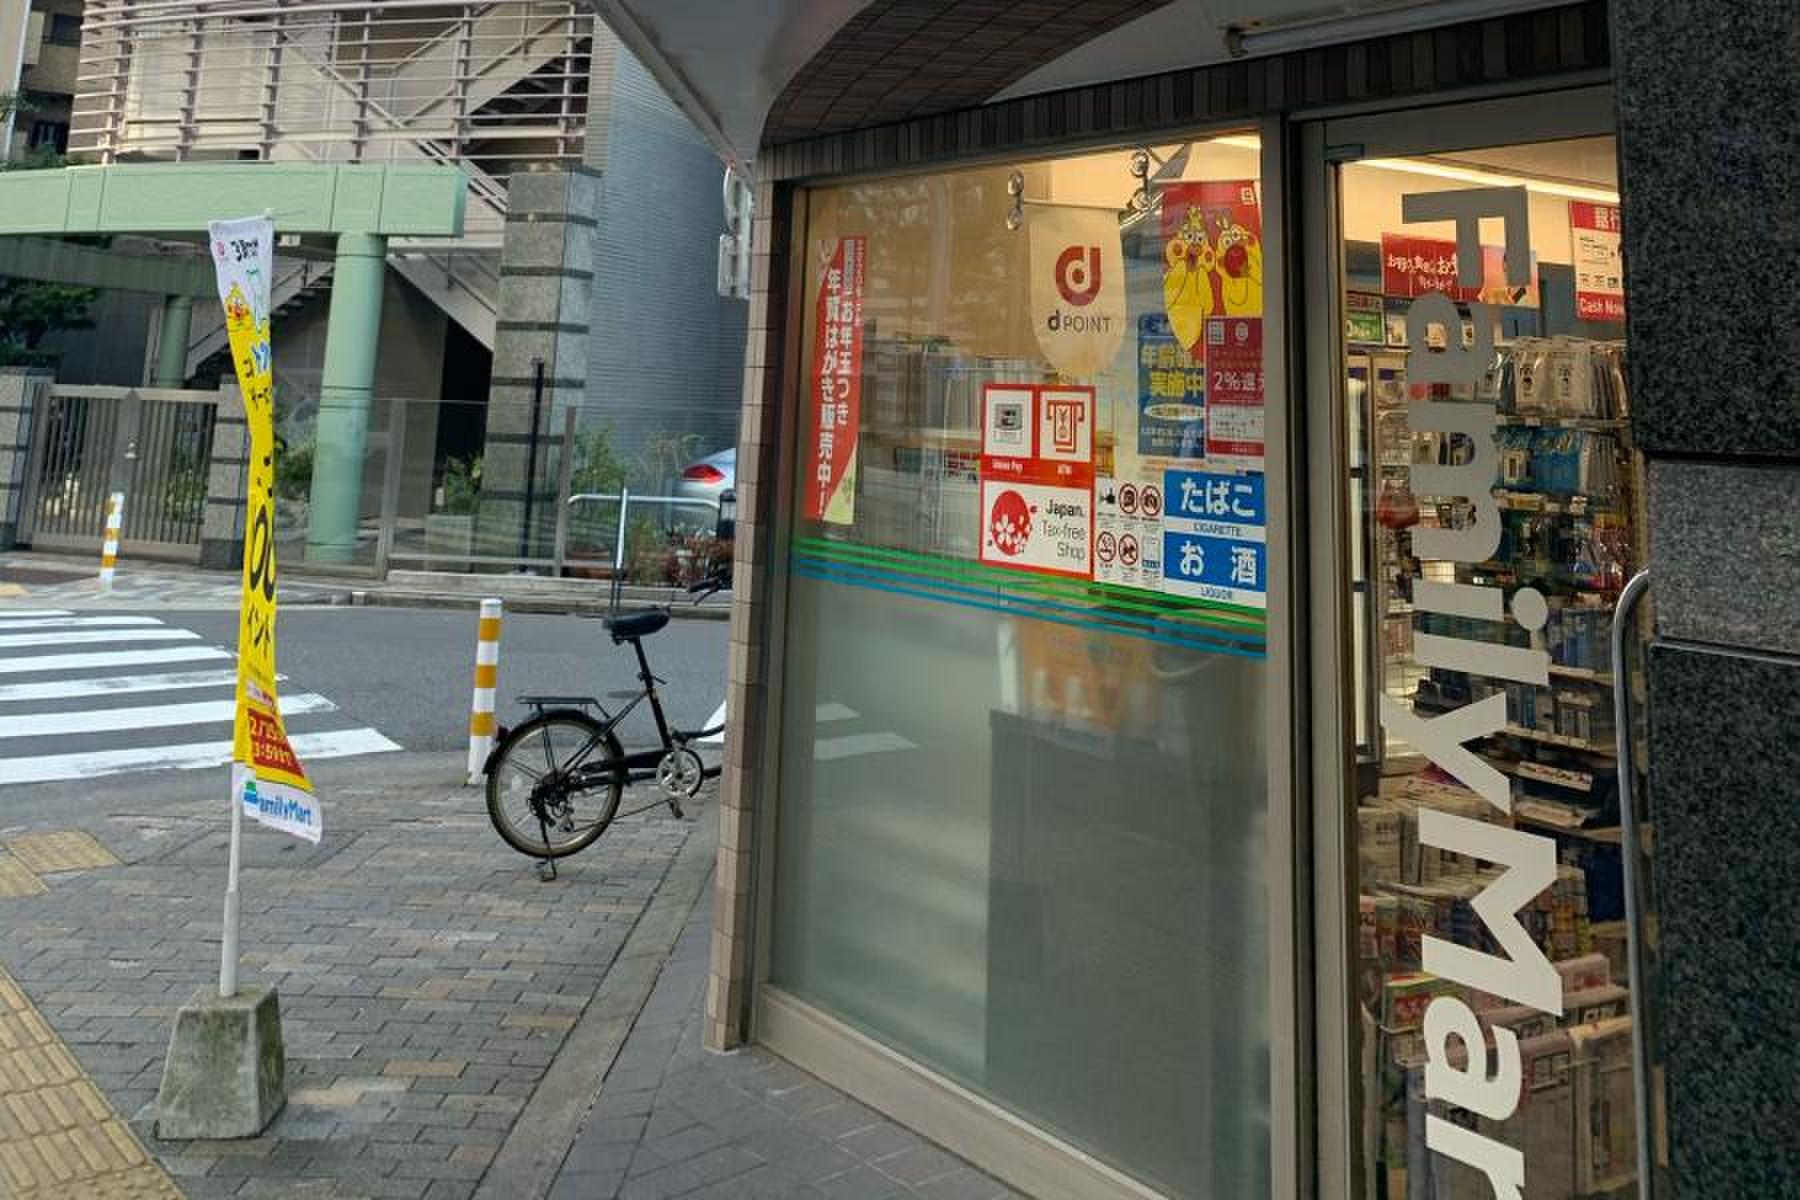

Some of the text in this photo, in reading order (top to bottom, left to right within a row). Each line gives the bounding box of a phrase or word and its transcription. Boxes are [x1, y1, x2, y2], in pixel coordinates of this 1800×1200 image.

[1180, 477, 1255, 517] たばこ
[1056, 542, 1085, 562] Shop
